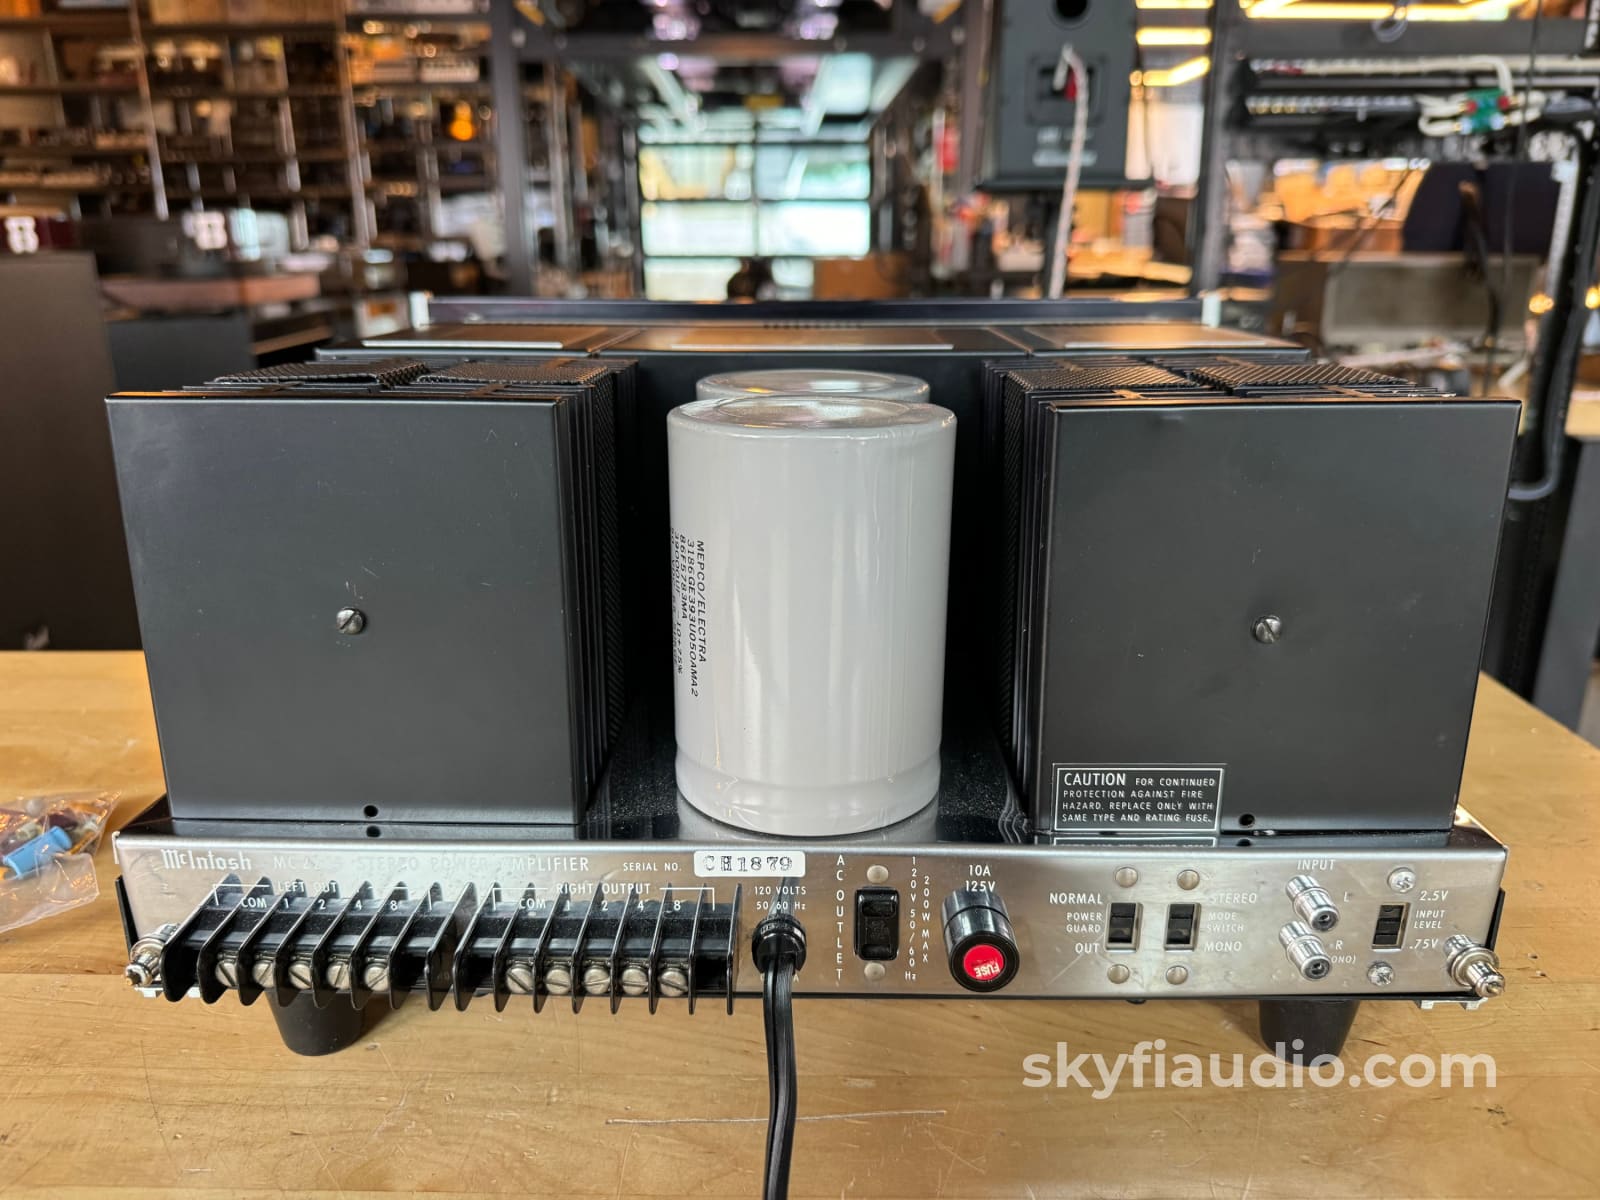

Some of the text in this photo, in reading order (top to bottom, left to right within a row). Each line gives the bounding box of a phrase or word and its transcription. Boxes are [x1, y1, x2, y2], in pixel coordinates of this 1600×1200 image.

[697, 540, 707, 662] MEPCO/ELECTRA
[1063, 773, 1216, 786] CAUTION FOR CONTINUED
[1063, 790, 1203, 799] PROTECTION AGAINST FIRE
[1109, 802, 1151, 810] REPLACE
[1157, 802, 1182, 811] ONLY
[1188, 802, 1214, 811] WITH
[1062, 814, 1211, 823] SAME TYPE AND RATING FUSE.
[160, 848, 252, 871] McIntosh
[503, 857, 590, 872] MPLIFIER
[623, 855, 793, 872] SERIAL NO. CH1879
[1297, 859, 1336, 870] INPUT
[968, 864, 991, 876] 10A
[277, 881, 305, 892] LEFT
[556, 882, 651, 894] RIGHT OUTPUT
[754, 886, 806, 895] 120 VOLTS
[965, 880, 996, 892] 125V
[1049, 892, 1103, 904] NORMAL
[1209, 893, 1257, 904] STEREO
[1343, 891, 1350, 902] L
[1420, 890, 1448, 901] 2.5V
[242, 898, 398, 910] COM 1 2 4 8
[519, 898, 681, 911] COM 1 2 4 8
[794, 902, 806, 910] Hz
[1066, 912, 1102, 920] POWER
[1208, 912, 1236, 920] MODE
[1416, 910, 1445, 918] INPUT
[1066, 924, 1100, 932] GUARD
[1207, 924, 1244, 932] SWITCH
[1414, 921, 1442, 929] LEVEL
[1075, 943, 1099, 953] OUT
[1205, 942, 1242, 952] MONO
[1335, 940, 1343, 950] R
[1409, 938, 1438, 950] .75V
[1330, 954, 1356, 964] ONO)
[973, 962, 1001, 978] FUSE
